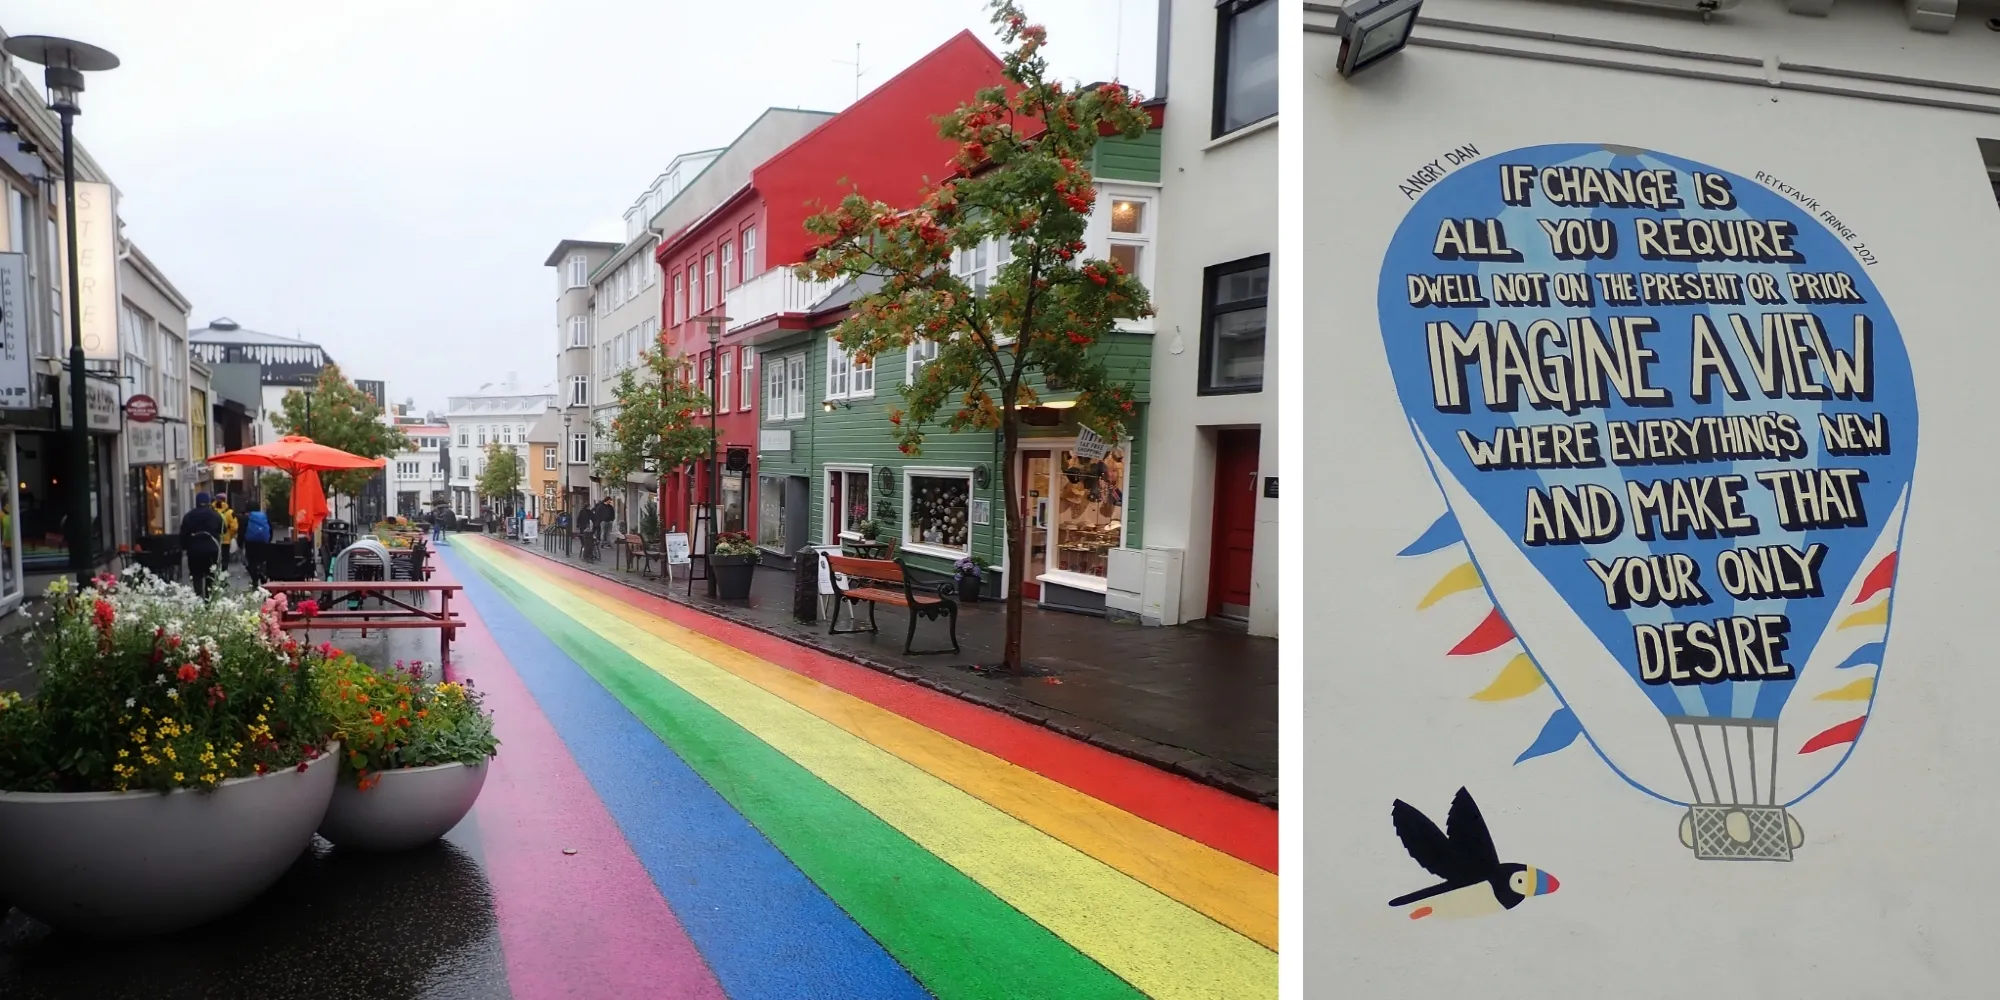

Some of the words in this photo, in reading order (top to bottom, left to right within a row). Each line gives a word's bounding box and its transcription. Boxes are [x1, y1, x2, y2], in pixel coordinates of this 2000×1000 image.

[1399, 159, 1447, 201] ANGRY
[1444, 143, 1481, 166] DAN
[1500, 165, 1538, 207] IF
[1540, 166, 1684, 212] CHANGE
[1692, 171, 1738, 211] IS
[1433, 217, 1524, 263] ALL
[1536, 218, 1618, 261] YOU
[1634, 218, 1806, 264] REQUIRE
[1755, 170, 1820, 212] REYKJAVÍK
[1820, 210, 1857, 242] FRINGE
[1853, 242, 1879, 267] 2021
[1406, 273, 1490, 308] DWELL
[1491, 273, 1551, 307] NOT
[1553, 273, 1595, 307] ON
[1595, 272, 1642, 307] THE
[1640, 272, 1746, 306] PRESENT
[1746, 272, 1788, 305] OR
[1786, 271, 1868, 305] PRIOR
[1425, 316, 1674, 416] IMAGINE
[1690, 313, 1751, 404] A
[1728, 312, 1874, 402] VIEW
[1077, 447, 1102, 455] SHOPPING
[1456, 421, 1606, 471] WHERE
[1607, 411, 1808, 466] EVERYTHING'S
[1818, 412, 1891, 457] NEW
[1248, 471, 1258, 491] 7
[1524, 484, 1625, 546] AND
[1627, 470, 1760, 541] MAKE
[1755, 468, 1870, 528] THAT
[1583, 553, 1713, 610] YOUR
[1716, 543, 1829, 600] ONLY
[1633, 614, 1796, 685] DESIRE
